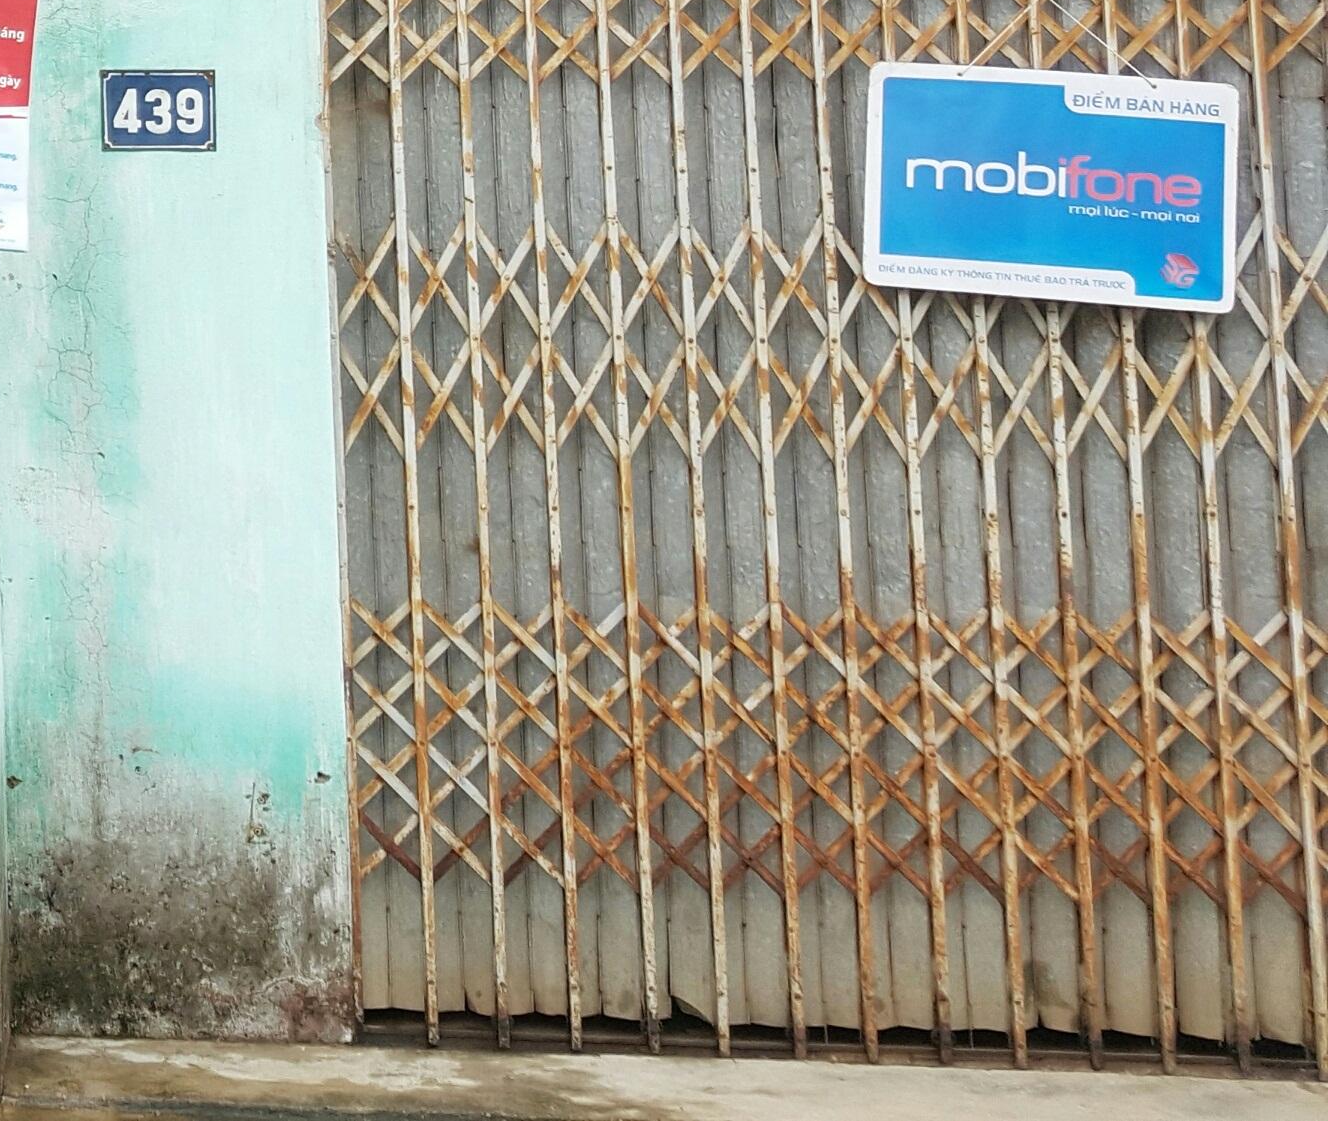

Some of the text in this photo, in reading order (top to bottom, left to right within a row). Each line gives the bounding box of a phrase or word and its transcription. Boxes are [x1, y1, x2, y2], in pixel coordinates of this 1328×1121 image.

[113, 88, 203, 134] 439
[1072, 90, 1220, 117] ĐIỂM BÁN HÀNG
[905, 150, 1203, 207] mobifone
[1068, 205, 1201, 224] mọi lúc mọi nơi
